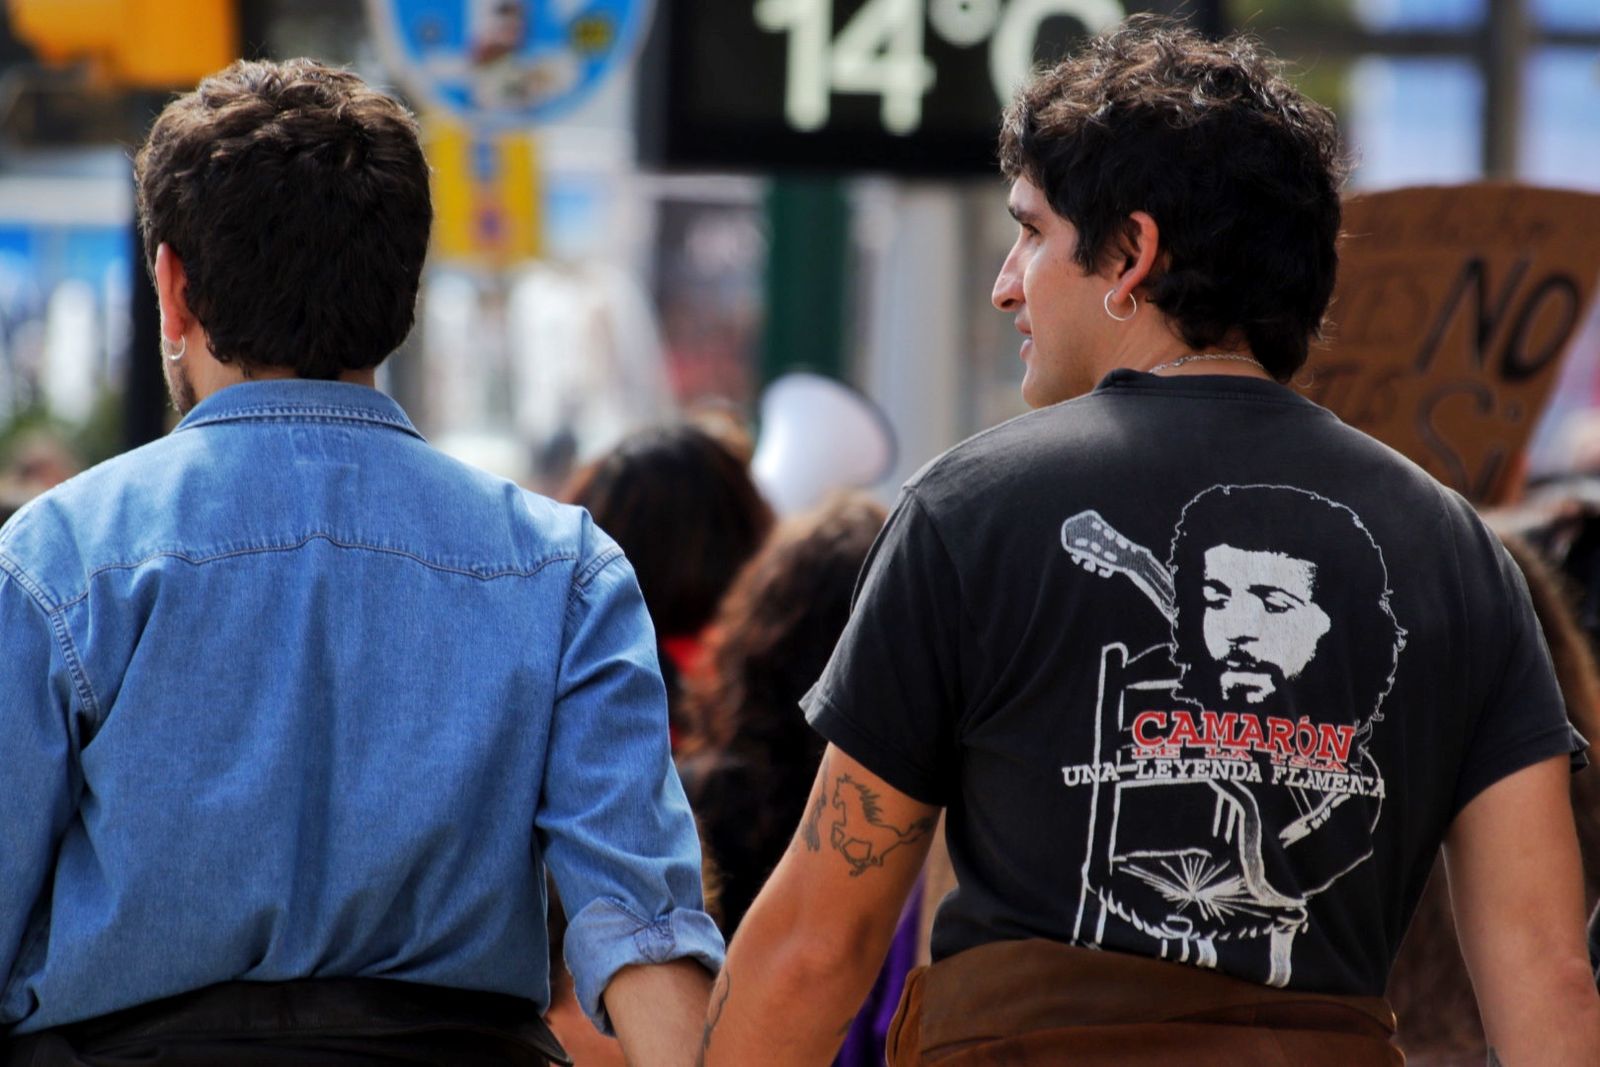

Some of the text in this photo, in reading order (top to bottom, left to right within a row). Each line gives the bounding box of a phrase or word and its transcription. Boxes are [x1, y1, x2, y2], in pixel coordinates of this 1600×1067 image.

[1414, 256, 1581, 382] NO
[1132, 711, 1356, 762] CAMARÓN
[1061, 762, 1121, 787] UNA
[1135, 759, 1263, 784] LEYENDA
